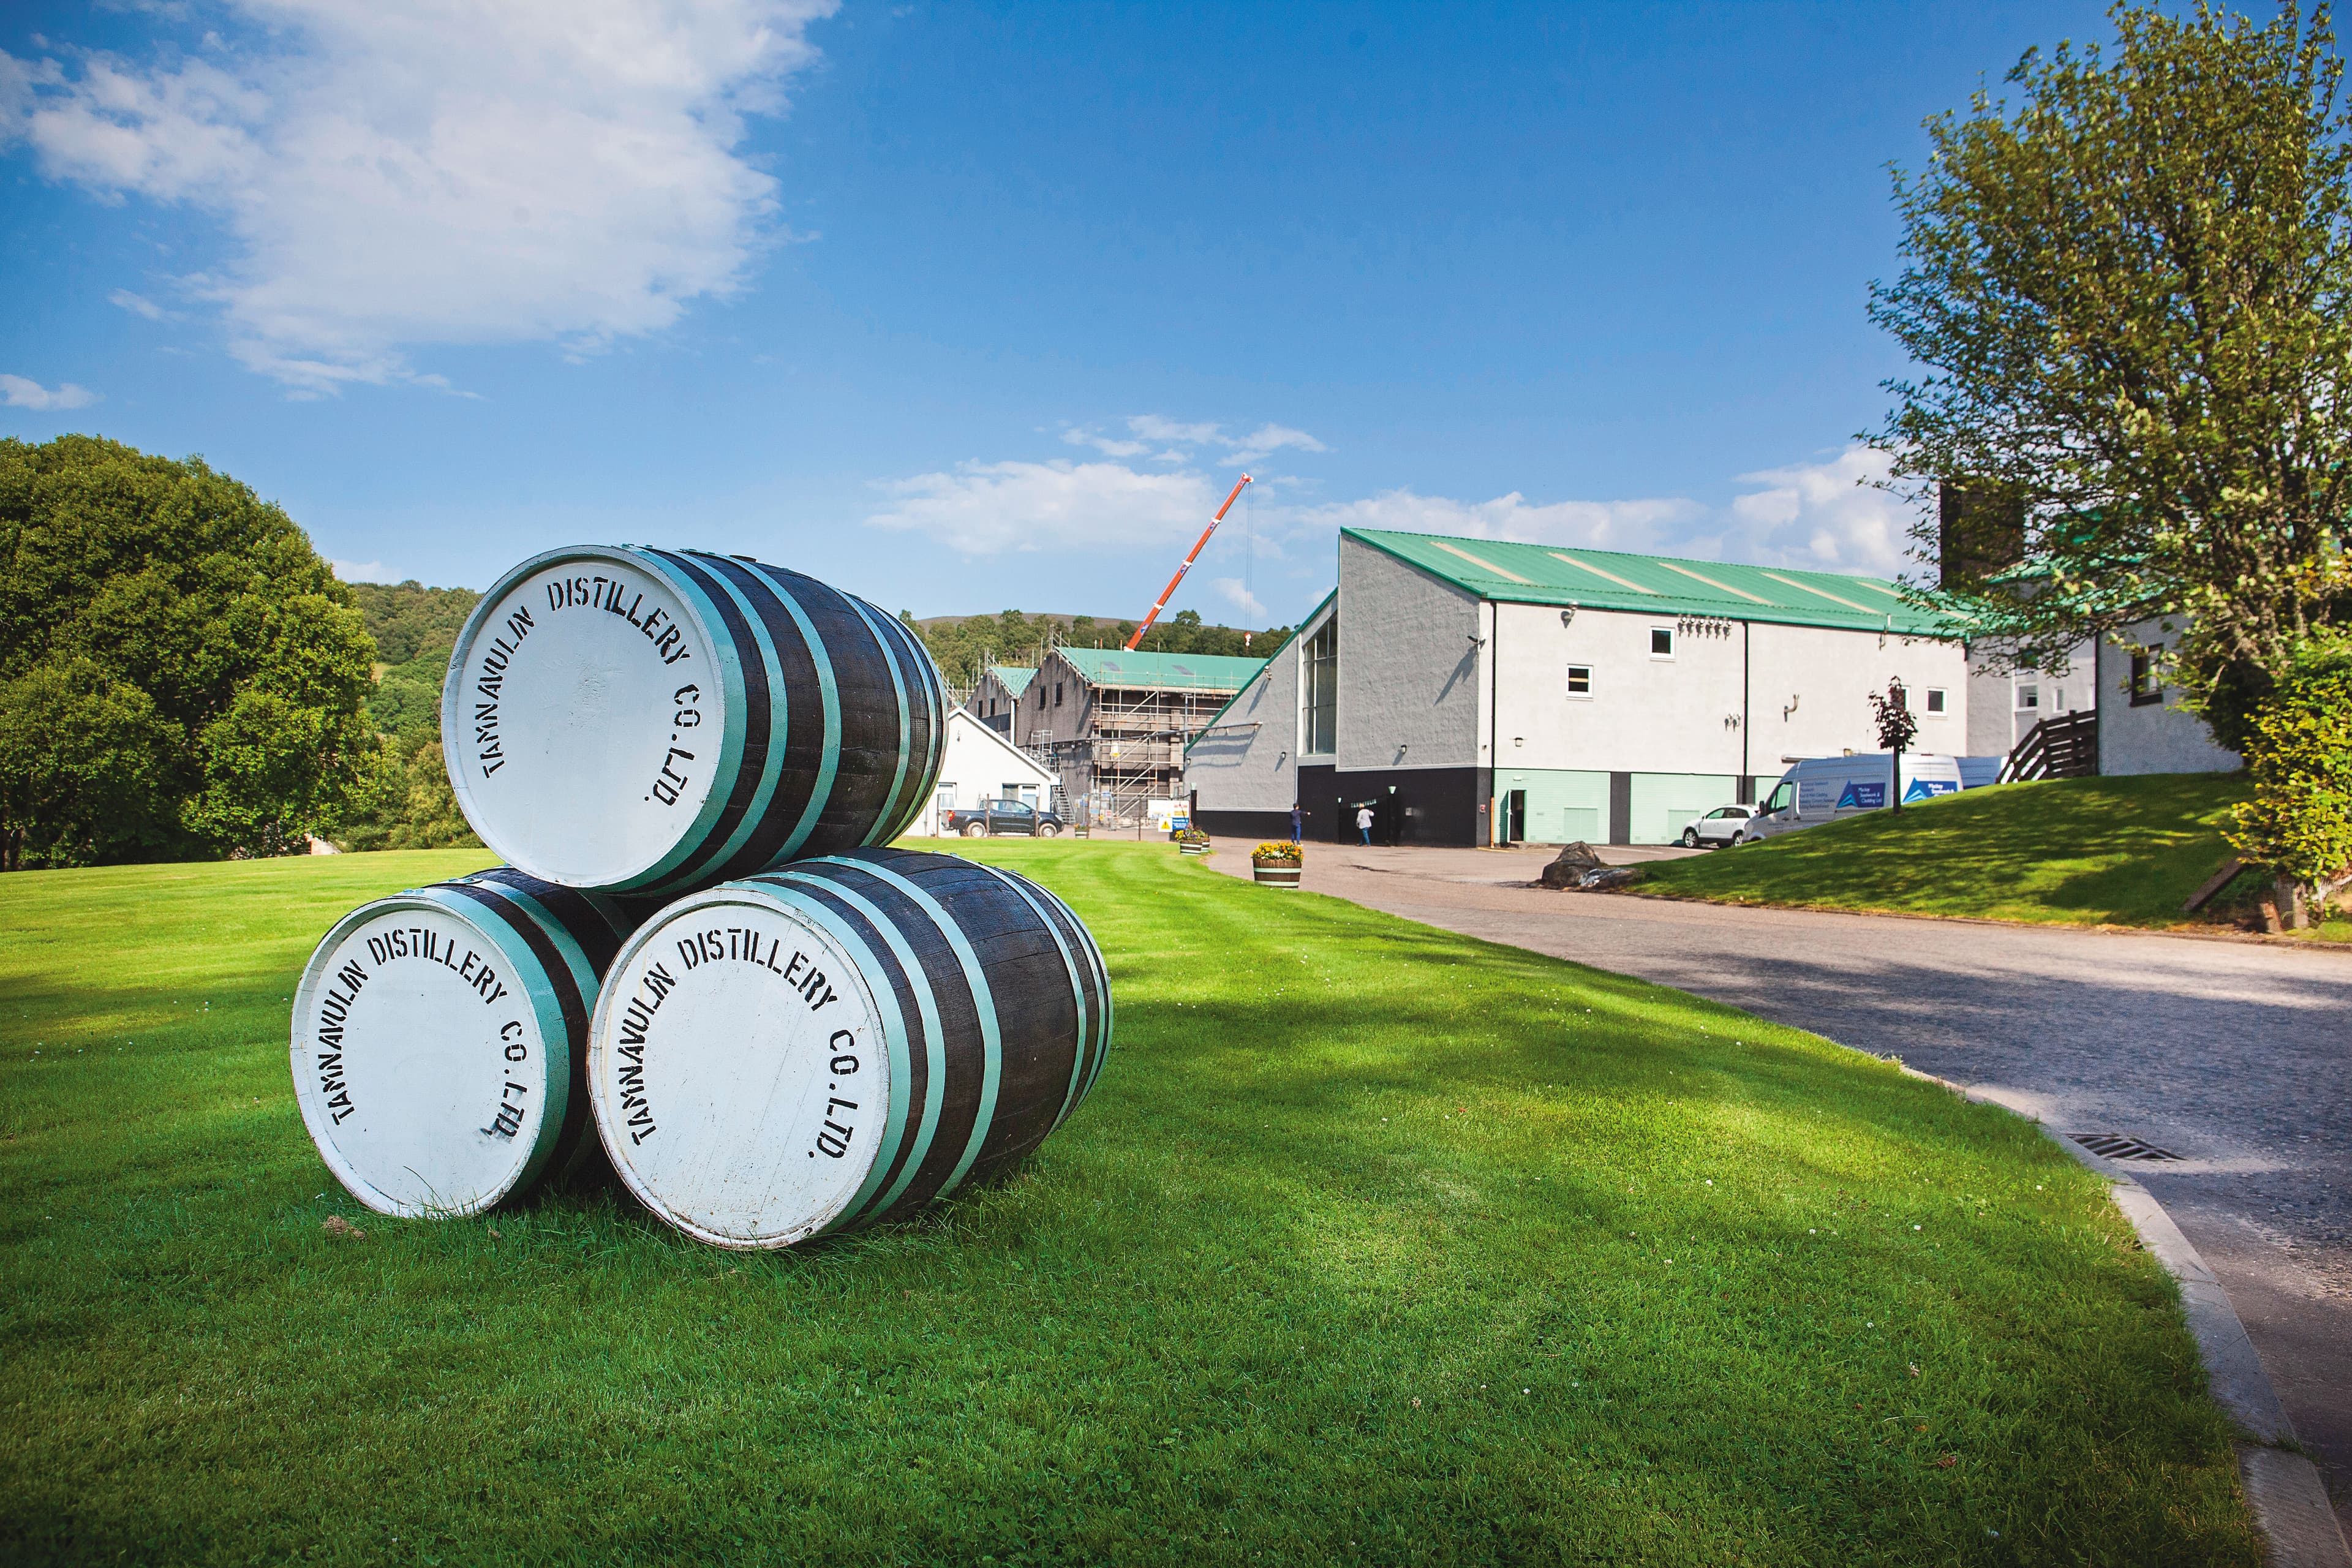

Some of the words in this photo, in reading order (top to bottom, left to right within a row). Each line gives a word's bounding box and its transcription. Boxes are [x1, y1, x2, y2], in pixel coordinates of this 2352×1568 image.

[475, 605, 535, 778] TANNAVULIN
[547, 576, 691, 666] DISTILLERY
[318, 959, 369, 1126] TANNAVULIN
[367, 928, 508, 1005] DISTILLERY
[618, 962, 676, 1146] TANNAVULIN
[677, 928, 838, 1011] DISTILLERY
